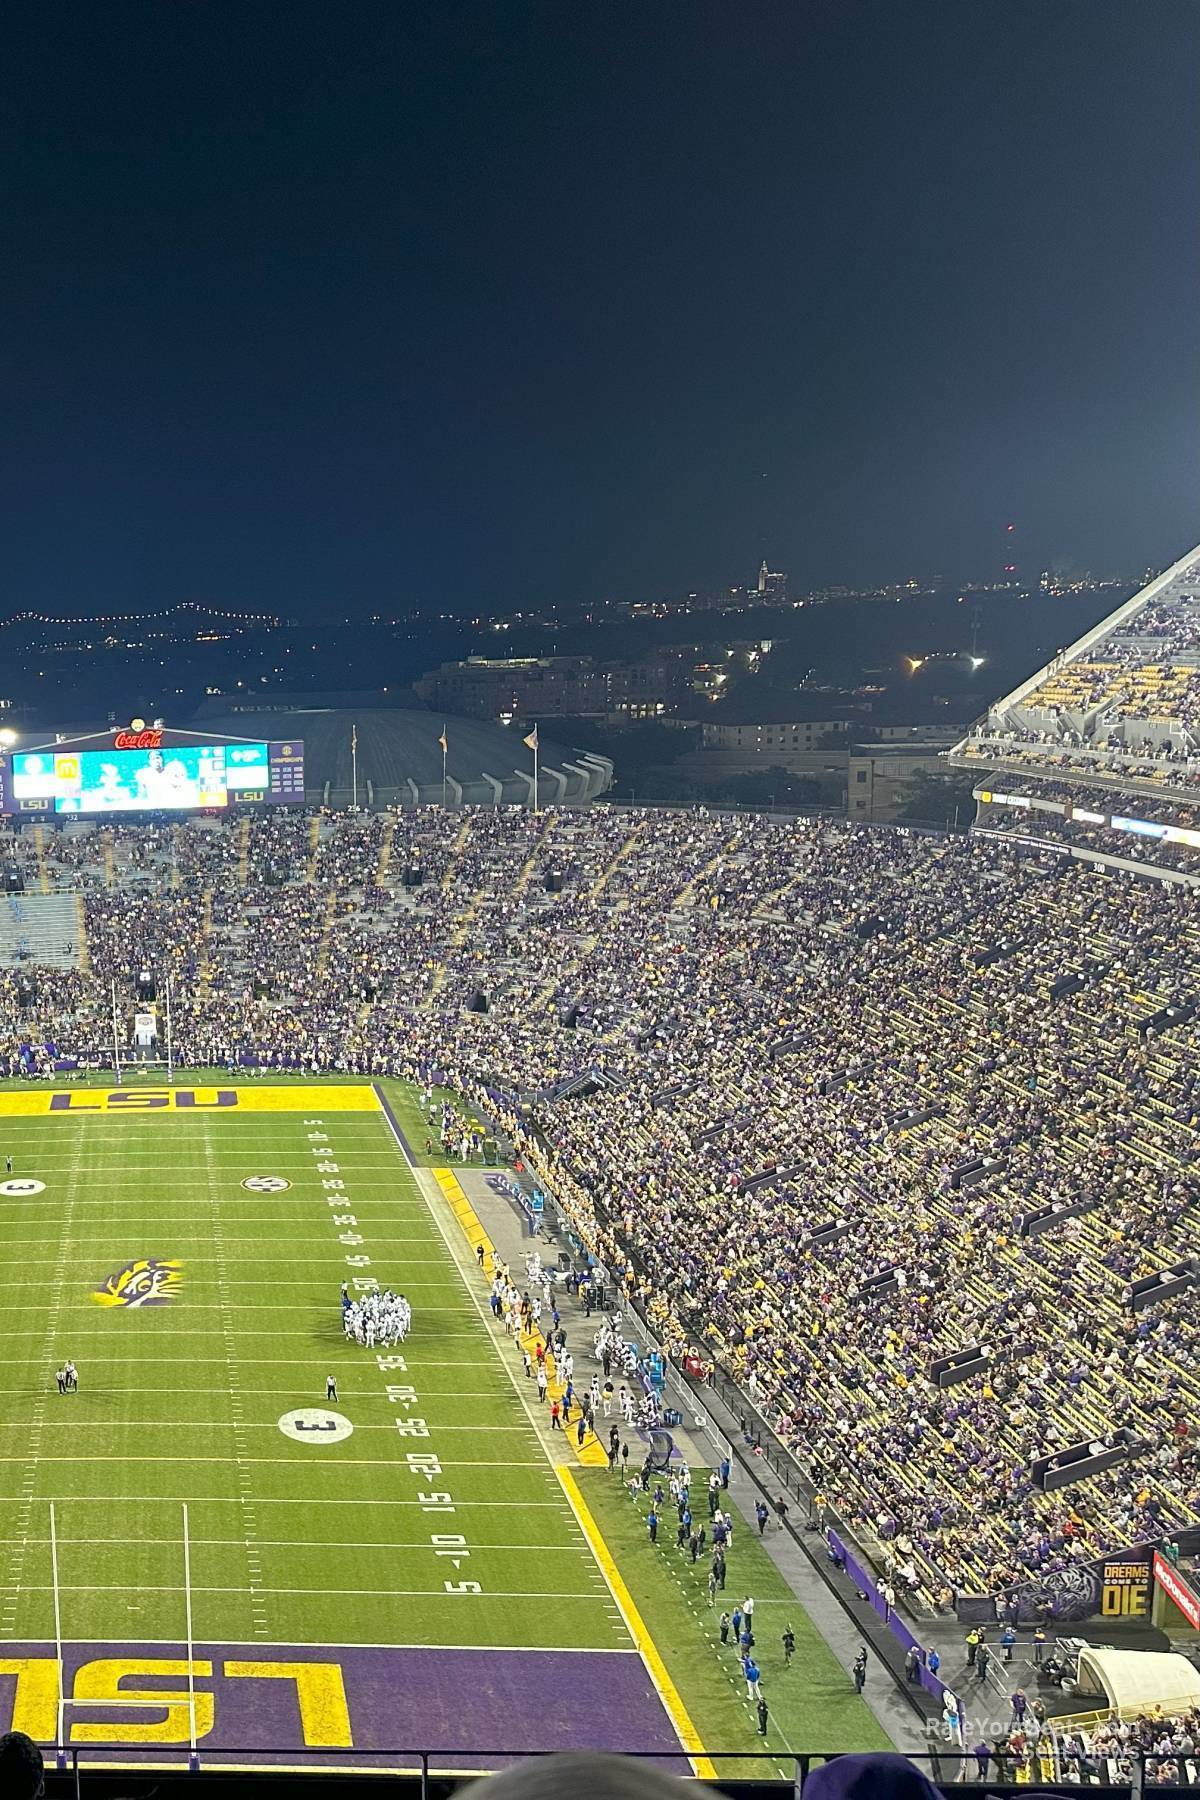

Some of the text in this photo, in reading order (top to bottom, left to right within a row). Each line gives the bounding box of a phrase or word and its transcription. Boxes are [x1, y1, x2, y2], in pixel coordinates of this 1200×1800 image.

[235, 791, 264, 802] LSU
[20, 800, 48, 810] LSU
[797, 817, 811, 826] 241
[1093, 863, 1106, 873] 300
[50, 1091, 238, 1110] LSU
[332, 1214, 357, 1225] 35
[345, 1255, 371, 1267] 45
[352, 1277, 379, 1290] 50
[375, 1355, 408, 1371] 35
[385, 1385, 418, 1402] 30
[294, 1420, 337, 1431] 3
[395, 1418, 430, 1437] 25
[406, 1453, 443, 1473] 20
[417, 1492, 456, 1513] 15
[430, 1534, 471, 1556] 10
[1104, 1566, 1149, 1578] DREAMS
[443, 1580, 482, 1593] 5
[1102, 1585, 1148, 1615] DIE
